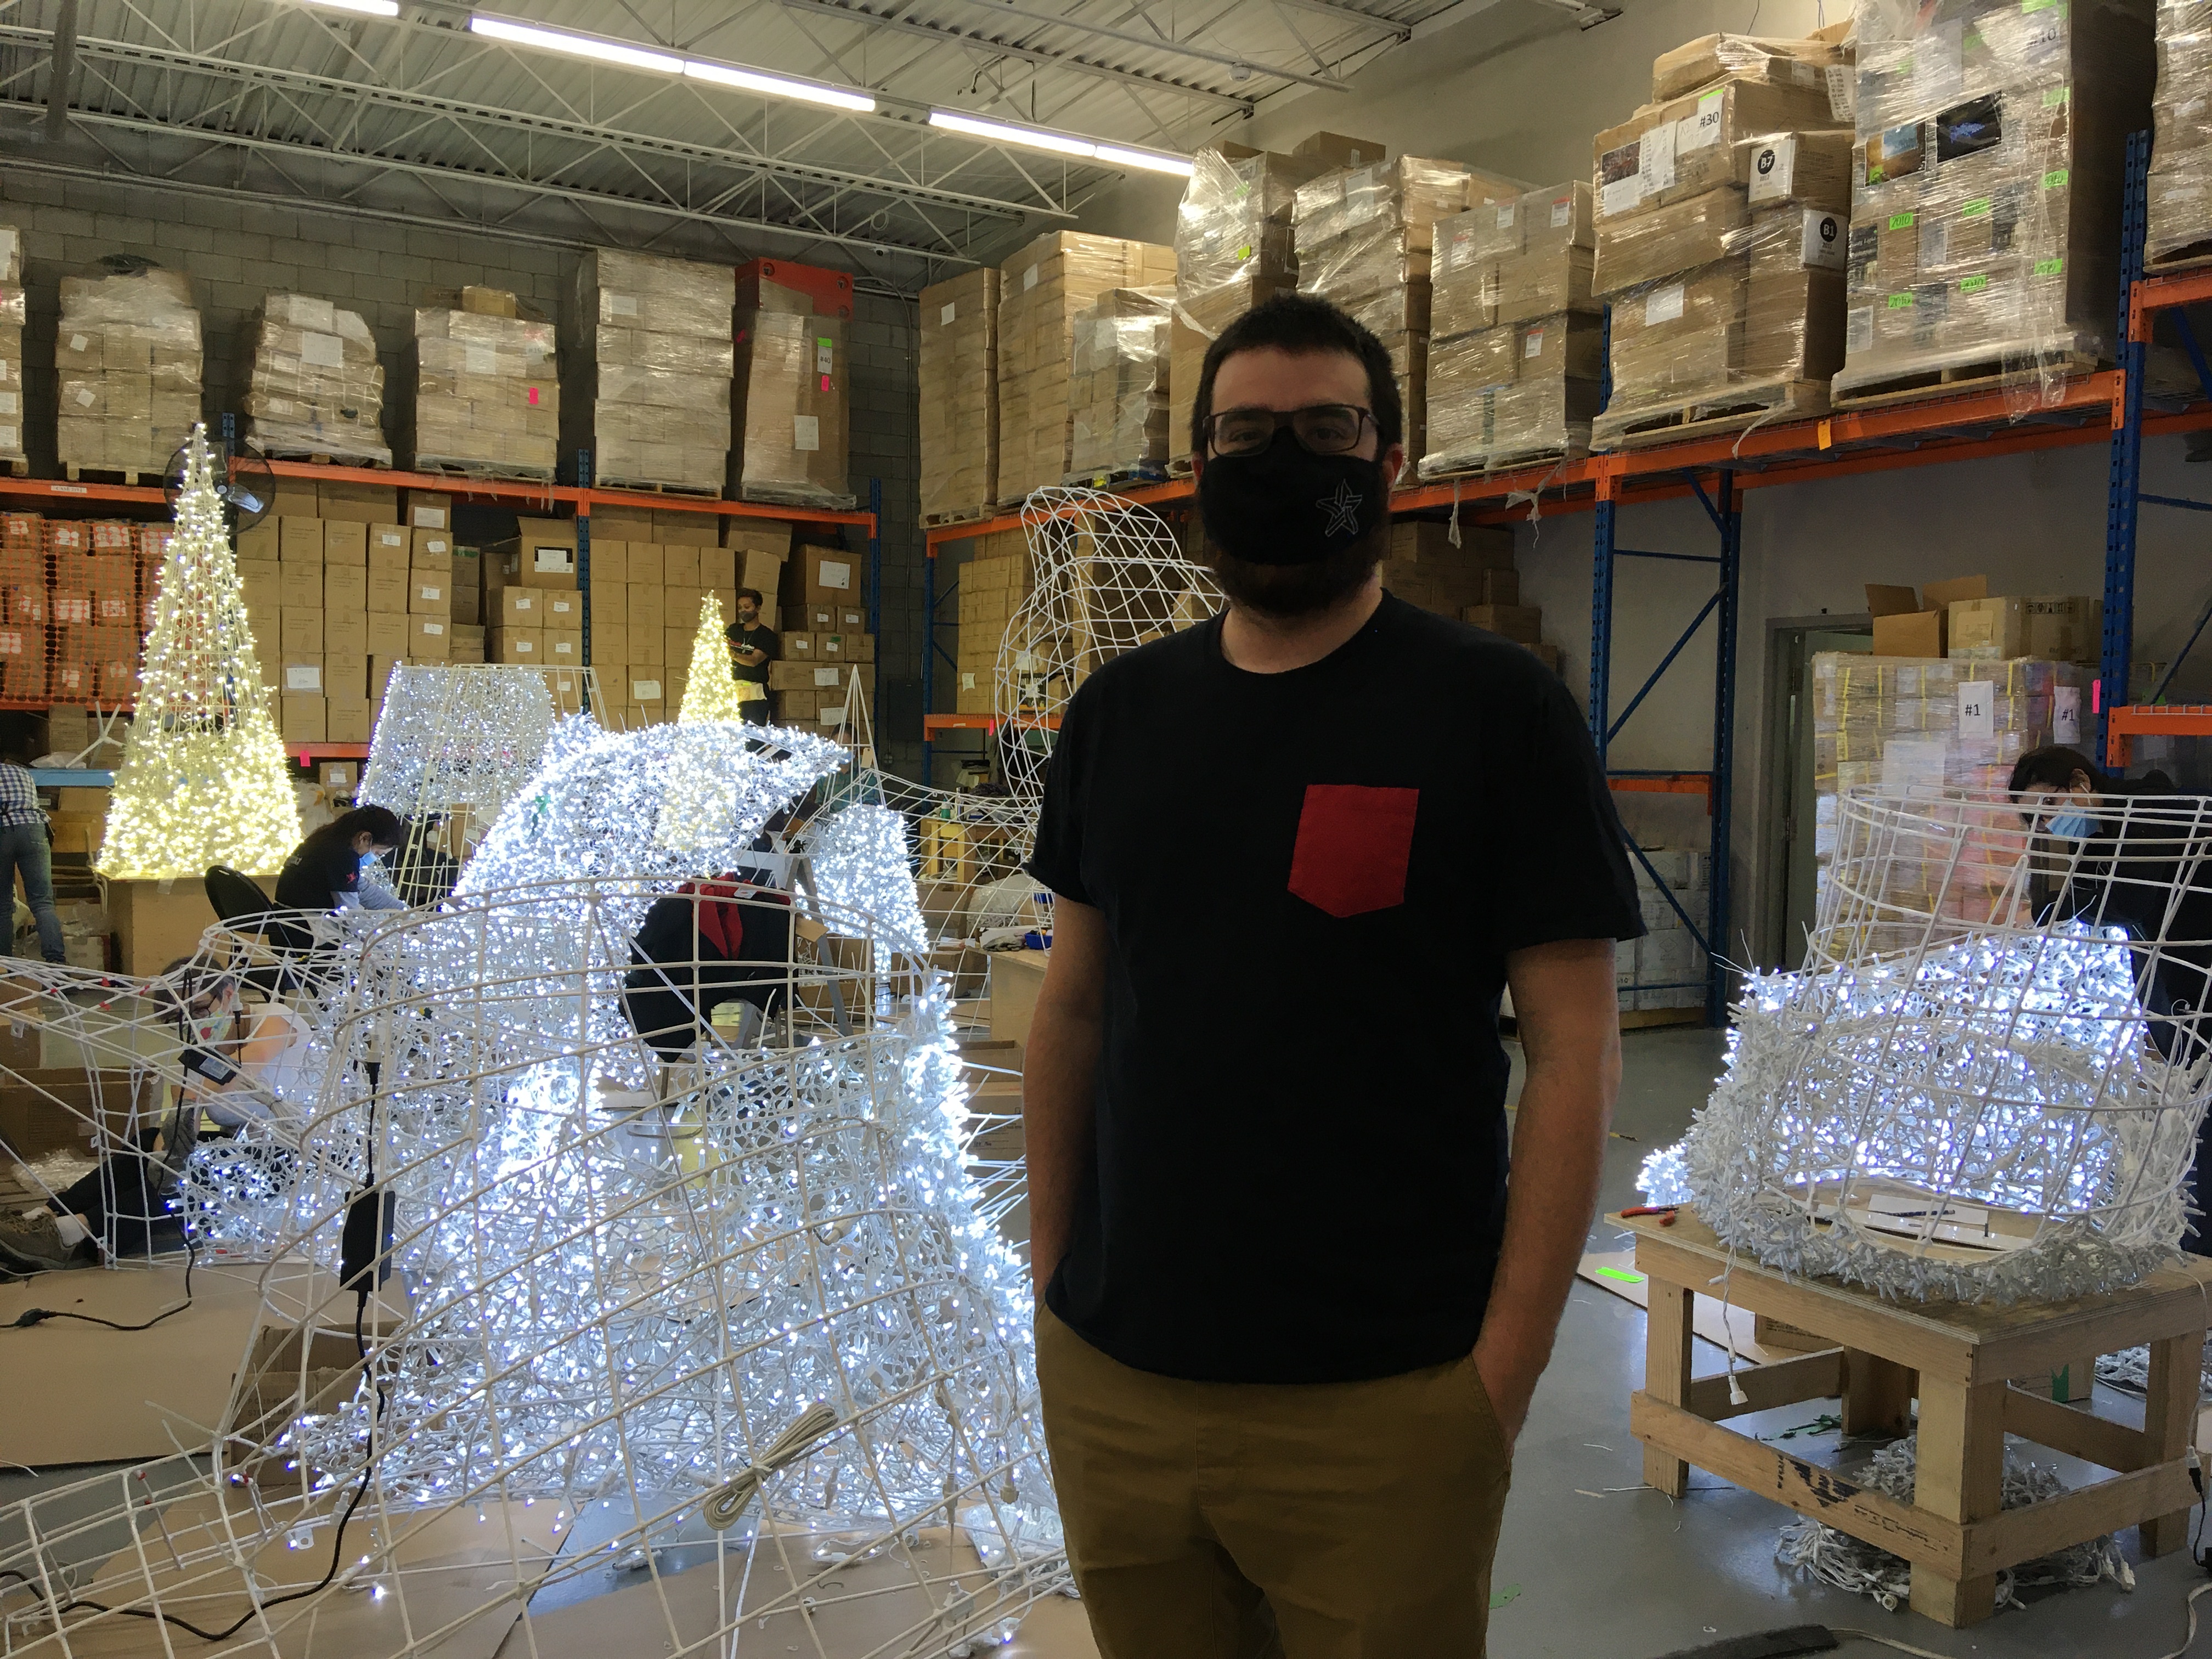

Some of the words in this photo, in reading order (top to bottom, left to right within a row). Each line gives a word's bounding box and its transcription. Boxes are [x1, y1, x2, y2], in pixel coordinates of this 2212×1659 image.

[1700, 111, 1719, 127] #30
[1760, 156, 1774, 169] B7
[1891, 215, 1910, 228] 2010
[1823, 224, 1835, 236] B1
[1965, 703, 1981, 716] #1
[2061, 708, 2075, 721] #1
